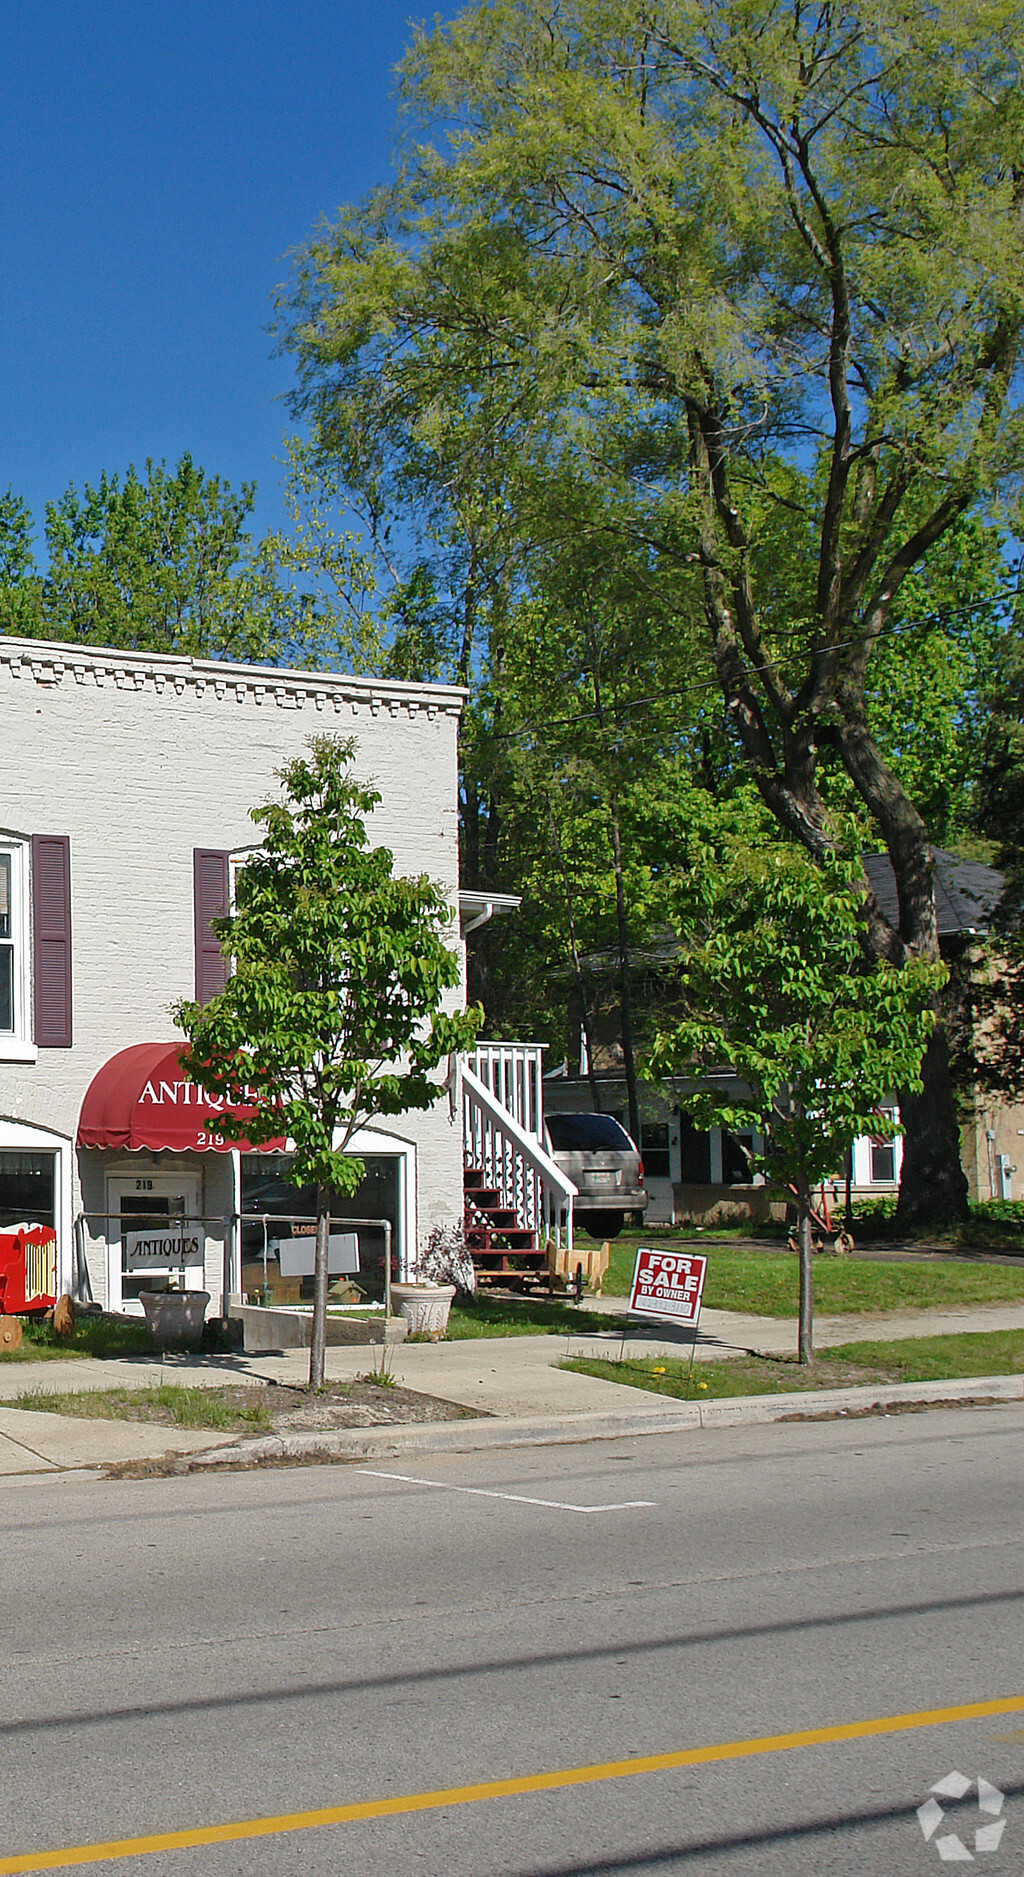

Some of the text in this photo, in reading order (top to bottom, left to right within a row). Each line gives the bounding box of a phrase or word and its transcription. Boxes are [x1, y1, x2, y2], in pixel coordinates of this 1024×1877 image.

[196, 1132, 225, 1146] 219
[136, 1180, 153, 1190] 219
[292, 1225, 318, 1234] CLOSE
[130, 1237, 199, 1256] ANTIQUES
[648, 1255, 692, 1274] FOR
[638, 1269, 698, 1292] SALE
[641, 1285, 691, 1301] BY OWNER
